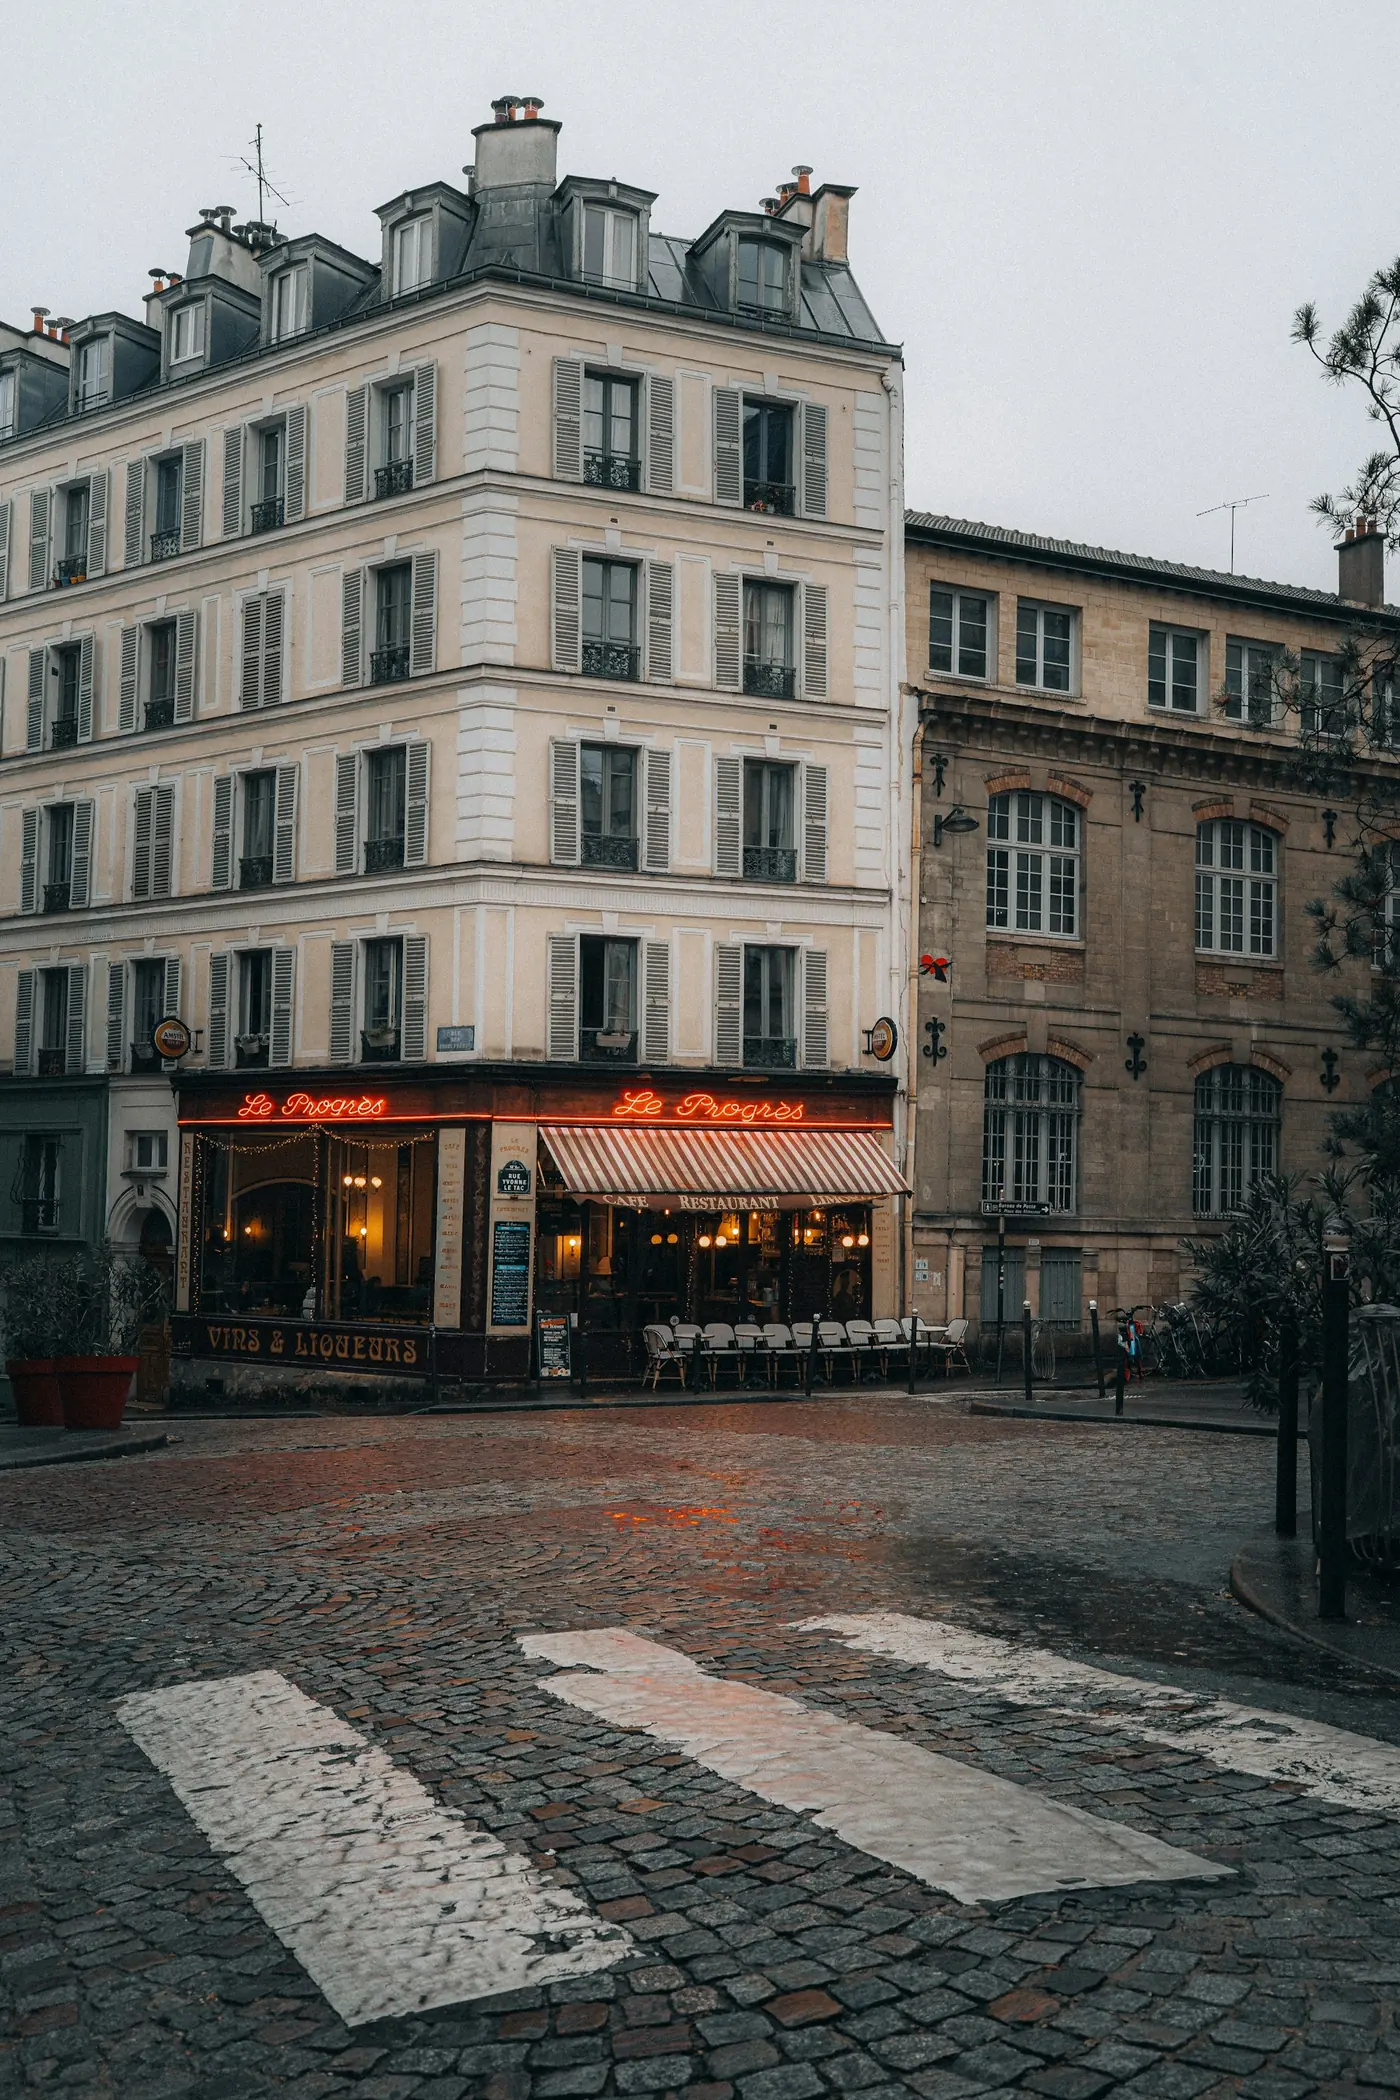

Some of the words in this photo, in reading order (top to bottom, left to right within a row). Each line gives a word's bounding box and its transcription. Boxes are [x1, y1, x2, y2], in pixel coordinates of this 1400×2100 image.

[238, 1093, 272, 1116] Le
[281, 1093, 385, 1116] Progrès
[614, 1091, 662, 1115] Le
[677, 1093, 804, 1122] Progrès
[602, 1194, 649, 1208] CAFE
[678, 1194, 779, 1210] RESTAURANT
[808, 1194, 862, 1206] LIMON
[206, 1326, 261, 1353] VINS
[270, 1330, 285, 1354] &
[294, 1332, 418, 1364] LIQUEURS
